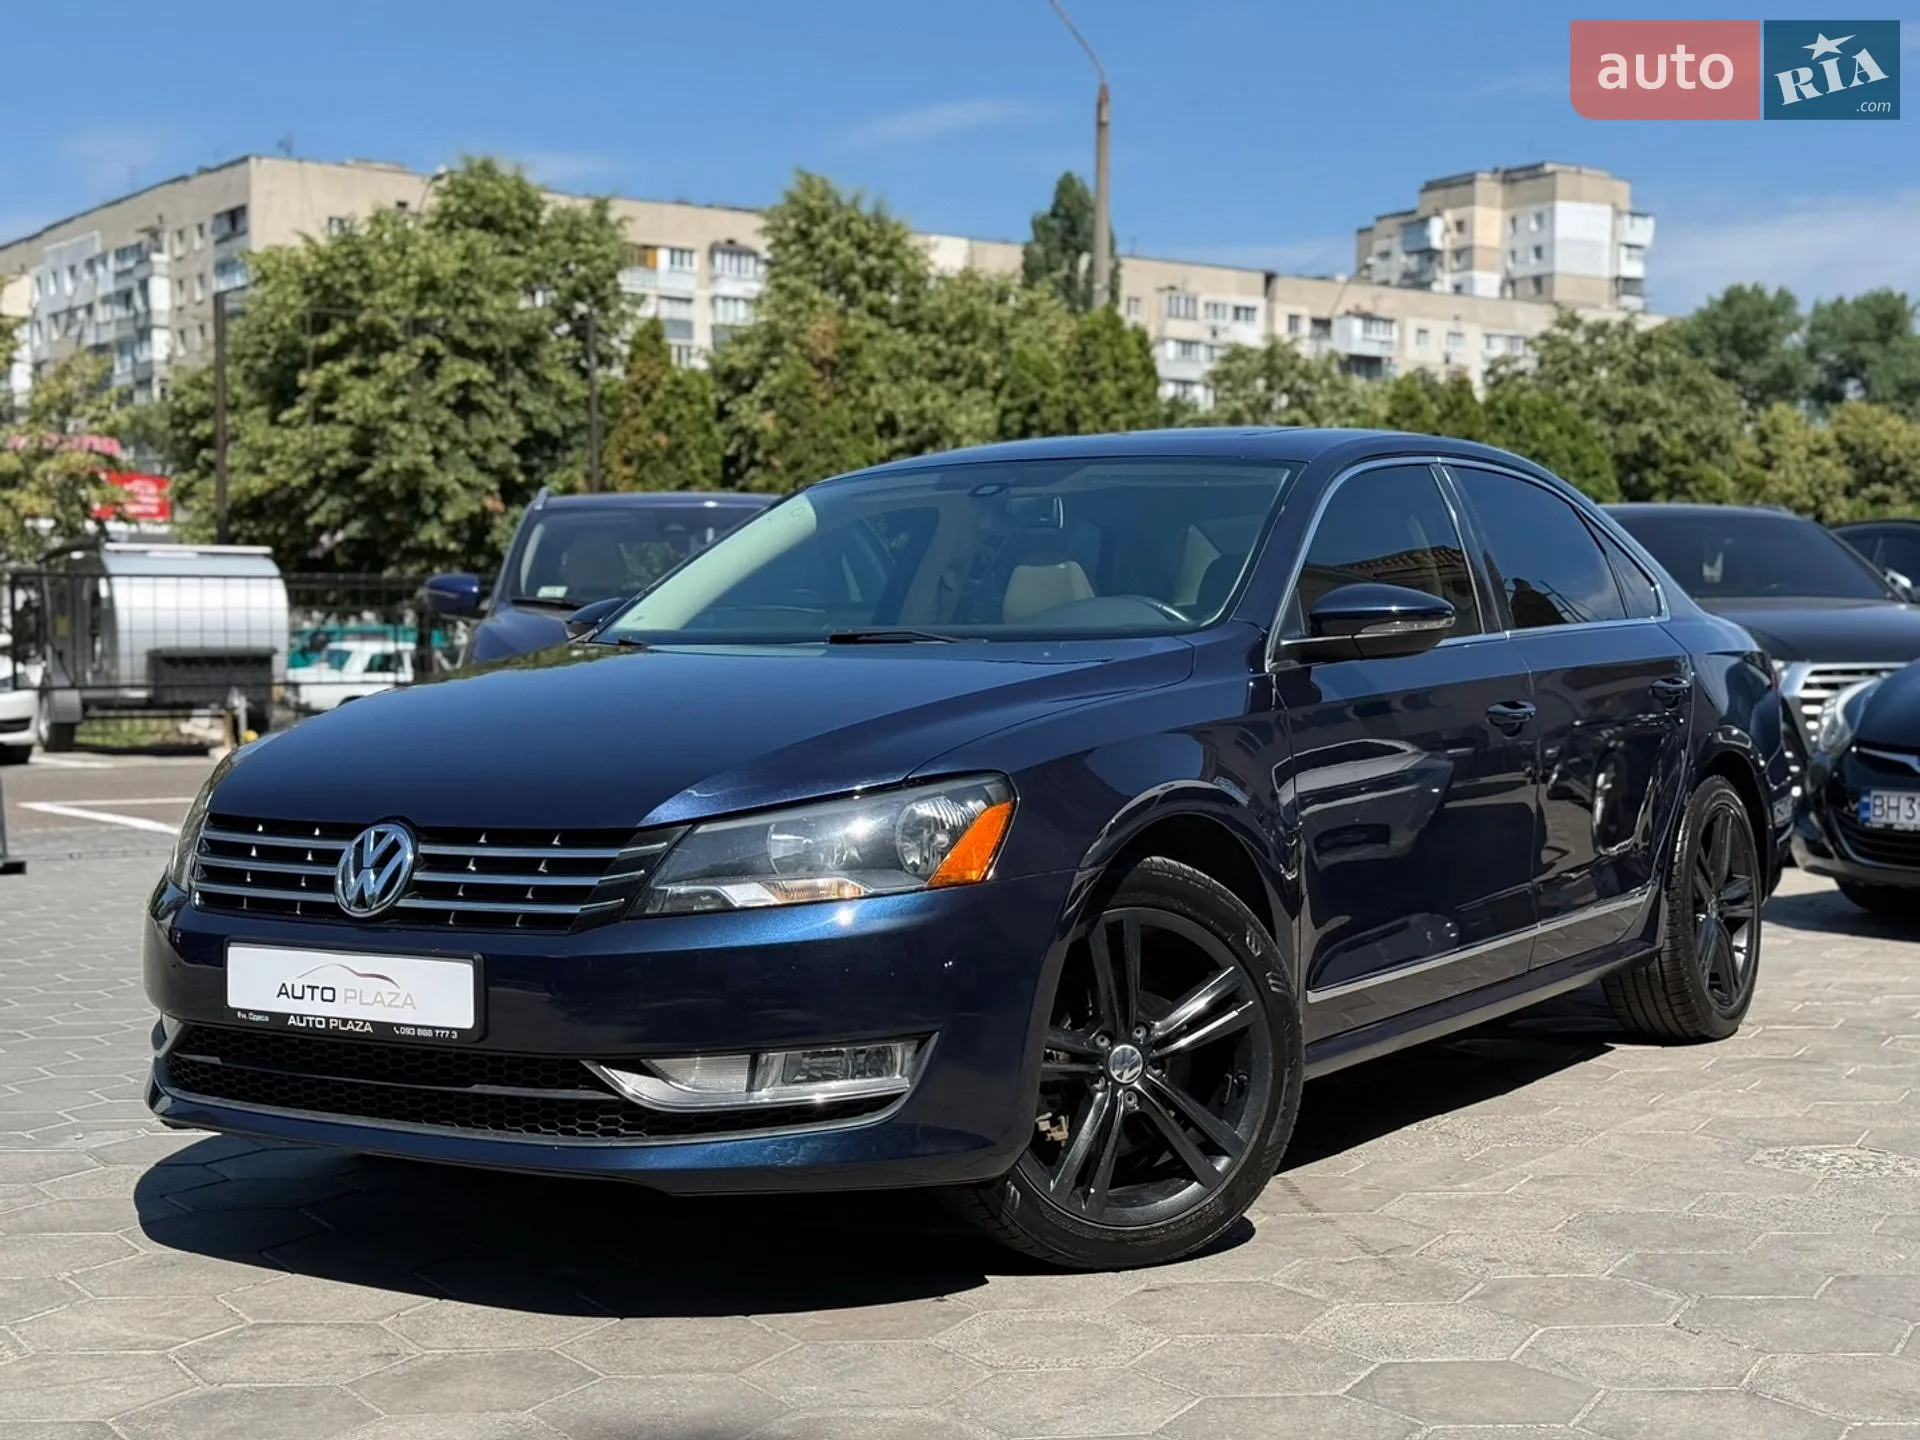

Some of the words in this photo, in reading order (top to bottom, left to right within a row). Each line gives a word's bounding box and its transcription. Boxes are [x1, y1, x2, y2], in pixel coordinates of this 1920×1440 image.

[276, 982, 336, 1003] AUTO
[343, 987, 417, 1011] PLAZA
[287, 1014, 326, 1029] AUTO
[329, 1018, 374, 1033] PLAZA
